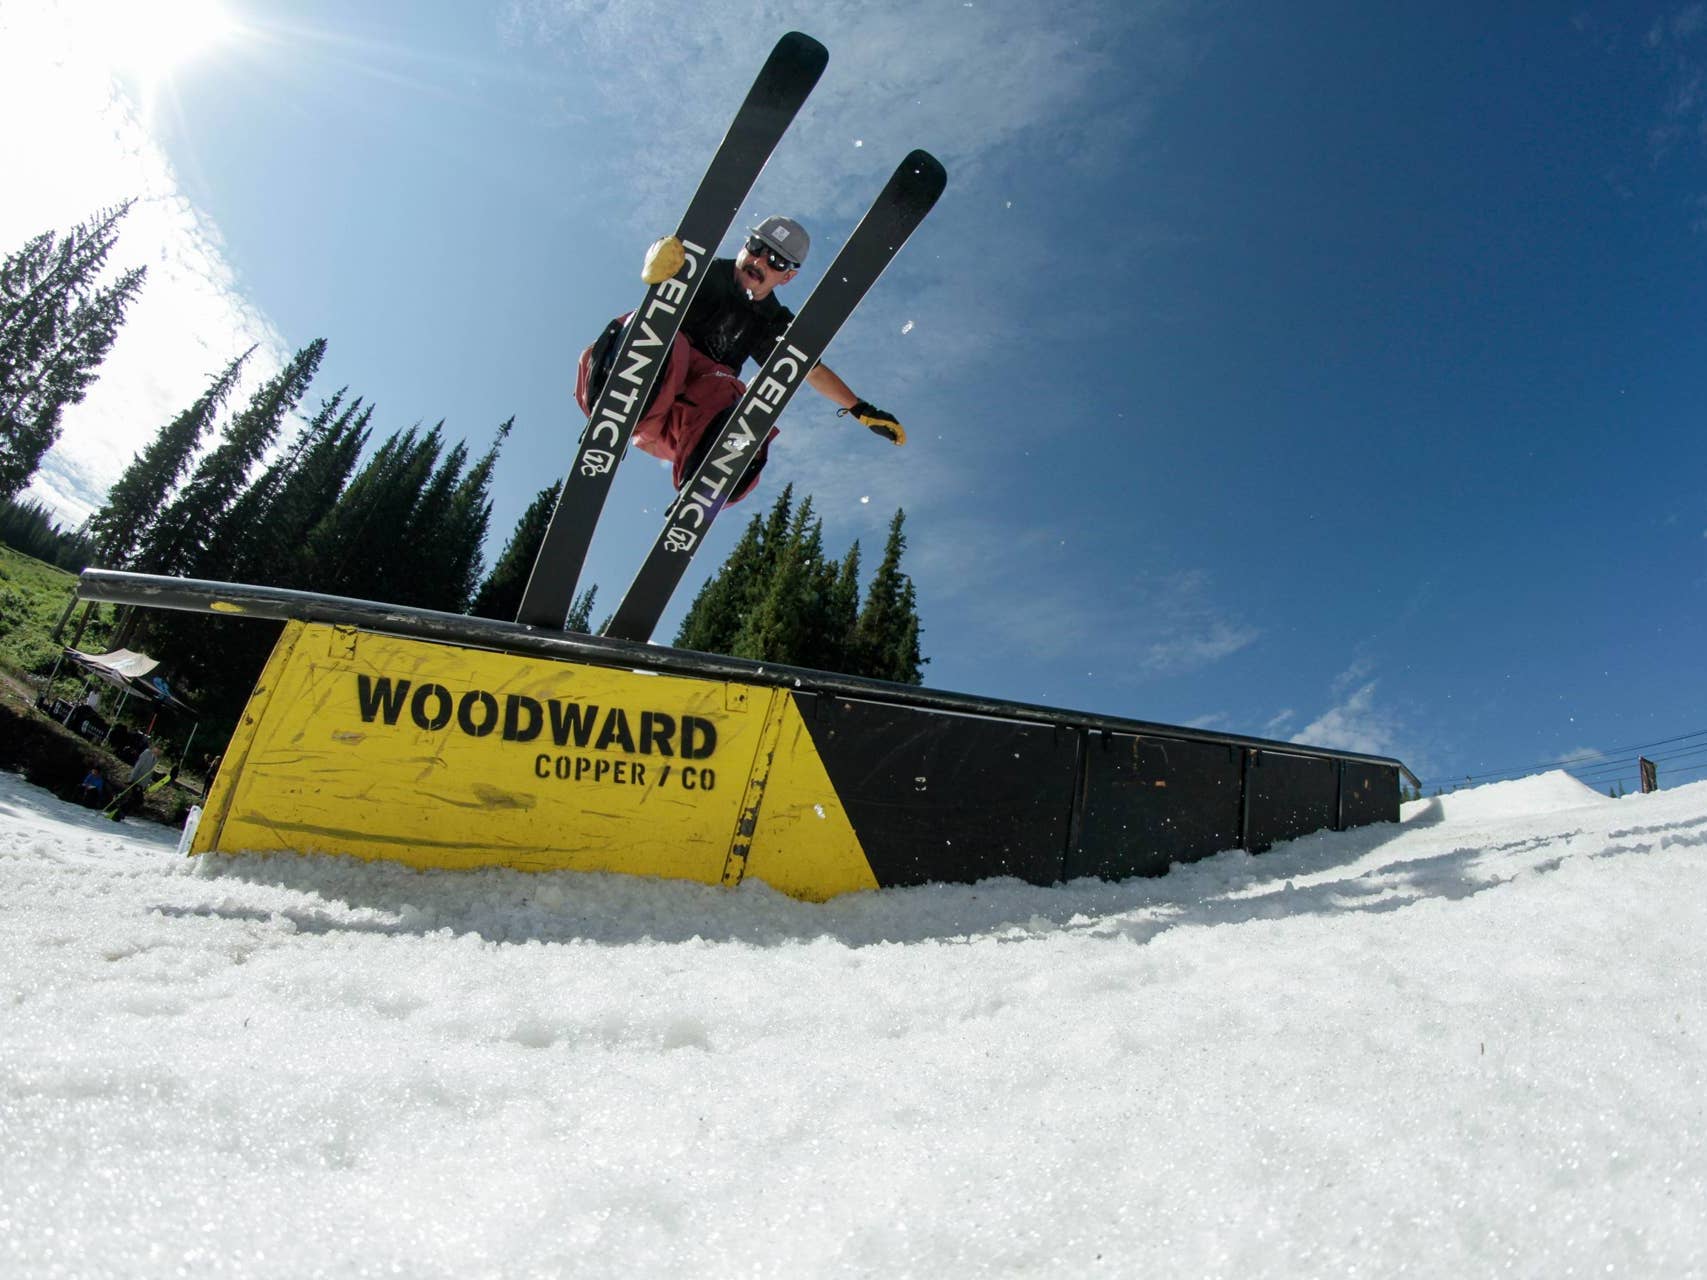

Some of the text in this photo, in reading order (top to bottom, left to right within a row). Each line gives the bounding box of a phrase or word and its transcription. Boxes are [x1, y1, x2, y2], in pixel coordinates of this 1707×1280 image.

[592, 239, 706, 448] ICELANTIC
[678, 344, 809, 528] ICELANTIC
[357, 674, 718, 760] WOODWARD
[534, 753, 716, 791] COPPER / CO
